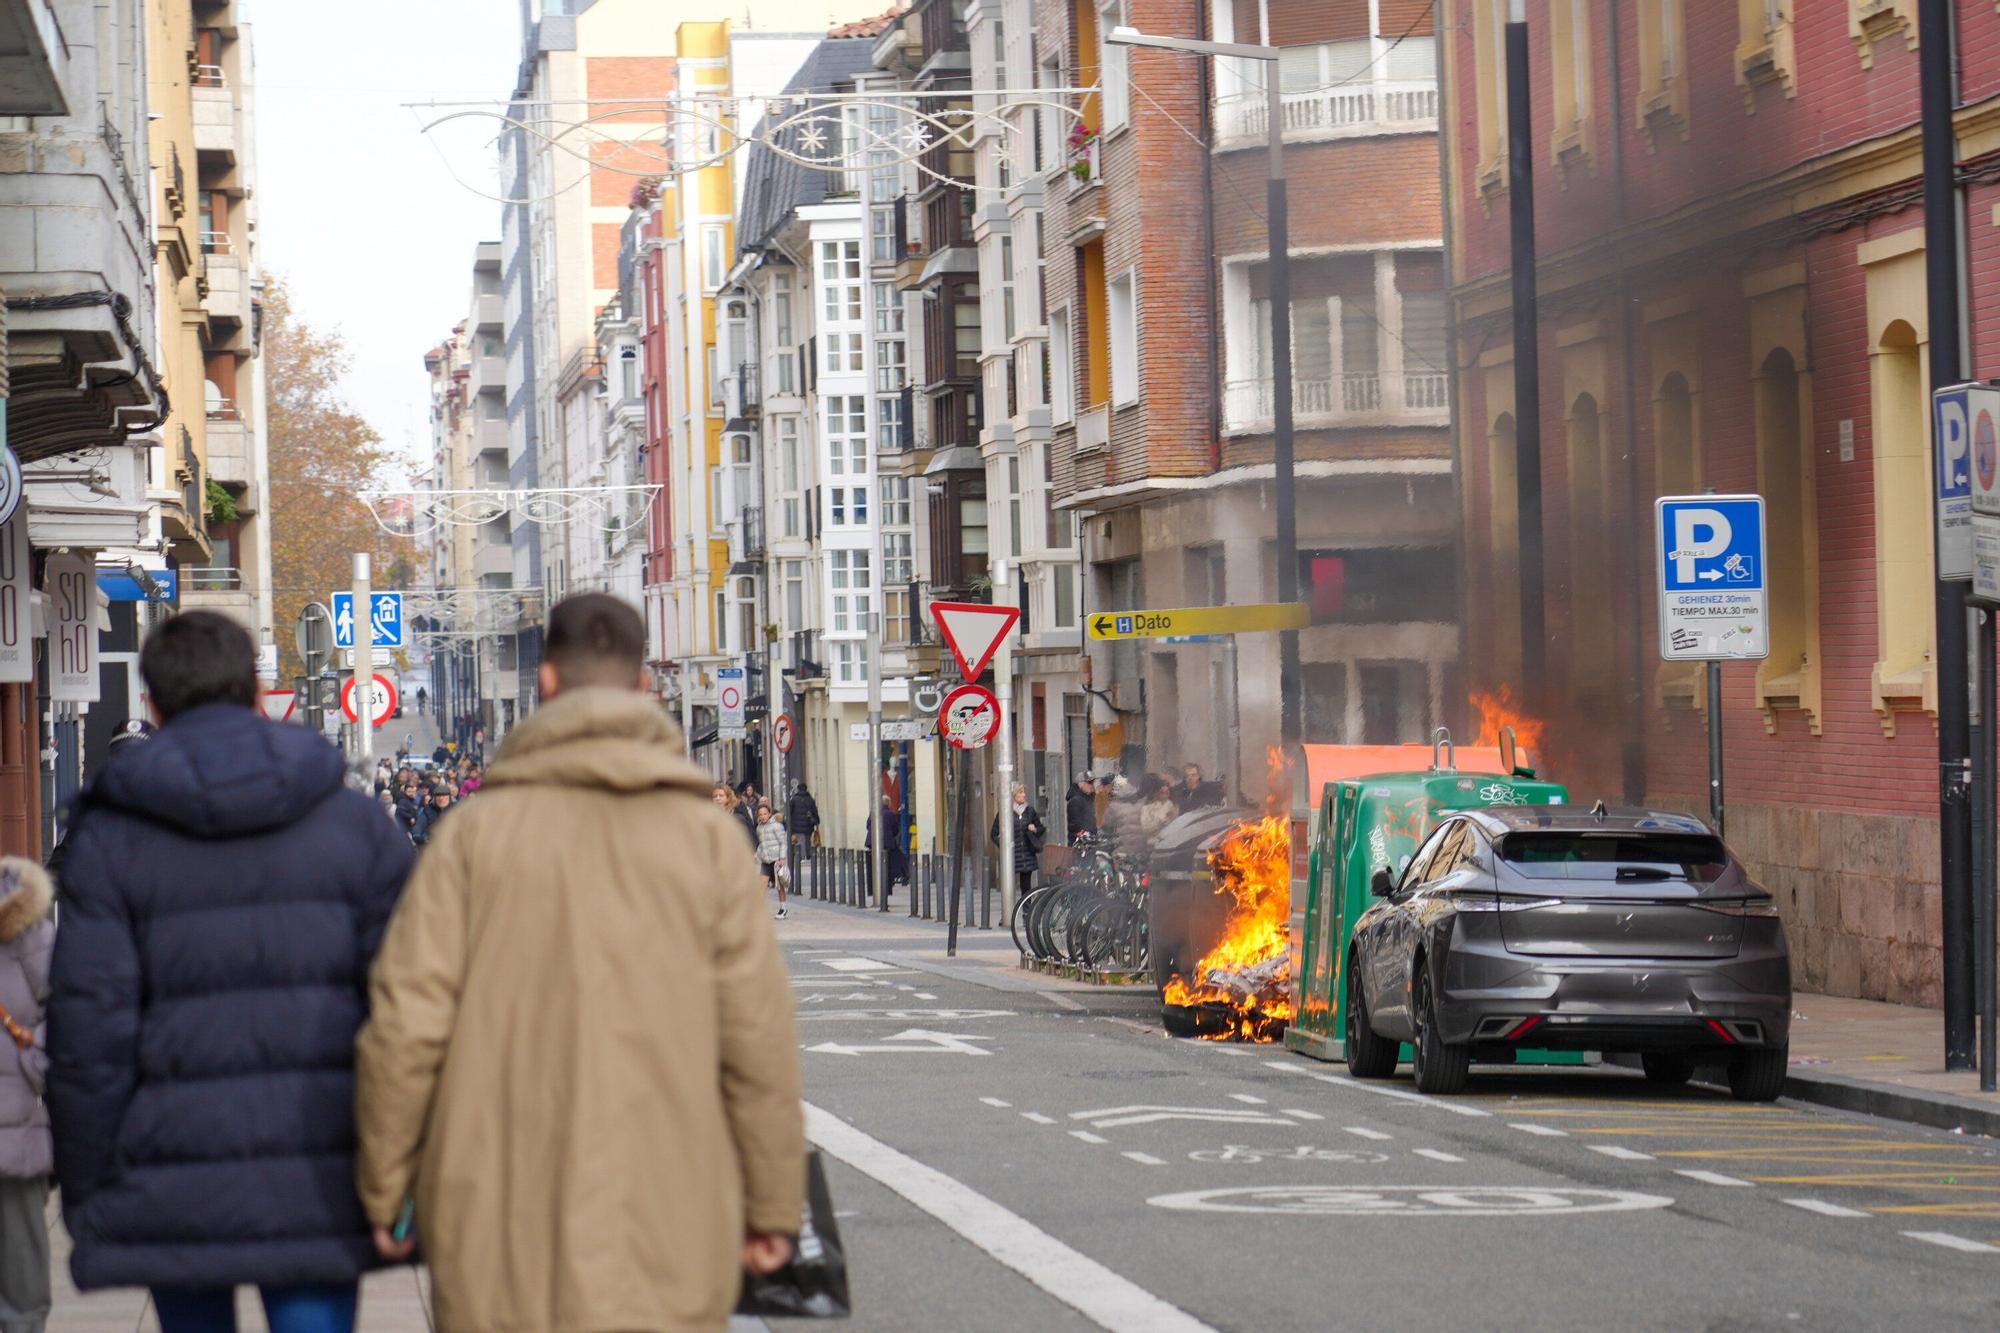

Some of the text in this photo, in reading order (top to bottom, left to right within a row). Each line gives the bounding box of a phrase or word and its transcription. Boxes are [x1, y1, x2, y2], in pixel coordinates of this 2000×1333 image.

[1940, 401, 1968, 490] P
[1674, 508, 1733, 584] P
[1679, 595, 1752, 604] GEHIENEZ 30min
[1672, 607, 1706, 616] TIEMPO
[1742, 606, 1759, 614] min
[1135, 614, 1172, 630] Dato
